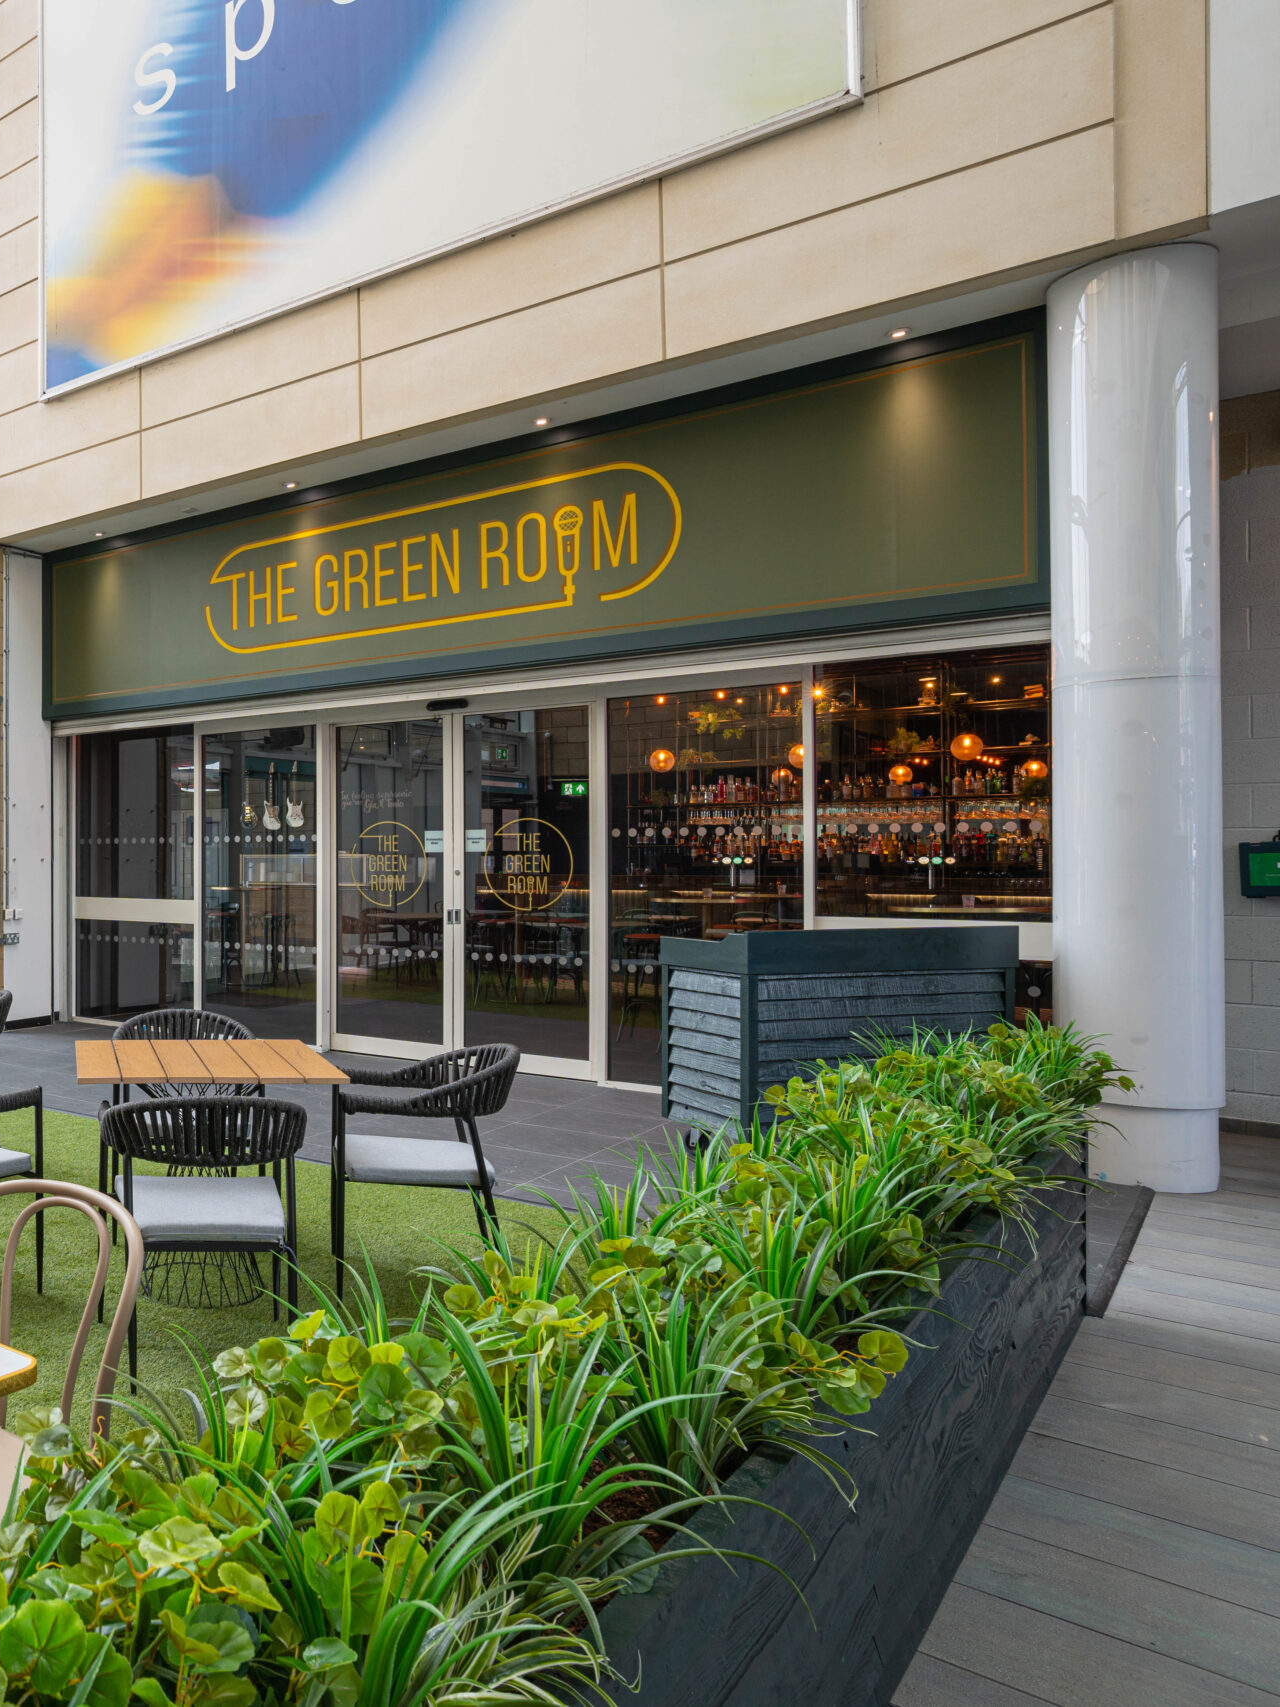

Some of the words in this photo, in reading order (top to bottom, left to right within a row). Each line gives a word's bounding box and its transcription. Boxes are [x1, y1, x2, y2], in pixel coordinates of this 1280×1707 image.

[219, 561, 298, 631] THE
[313, 528, 460, 618] GREEN
[479, 492, 638, 590] ROOM
[376, 834, 400, 852] THE
[516, 832, 542, 852] THE
[368, 854, 408, 872] GREEN
[505, 853, 551, 873] GREEN
[370, 874, 406, 892] ROOM
[507, 874, 548, 895] ROOM
